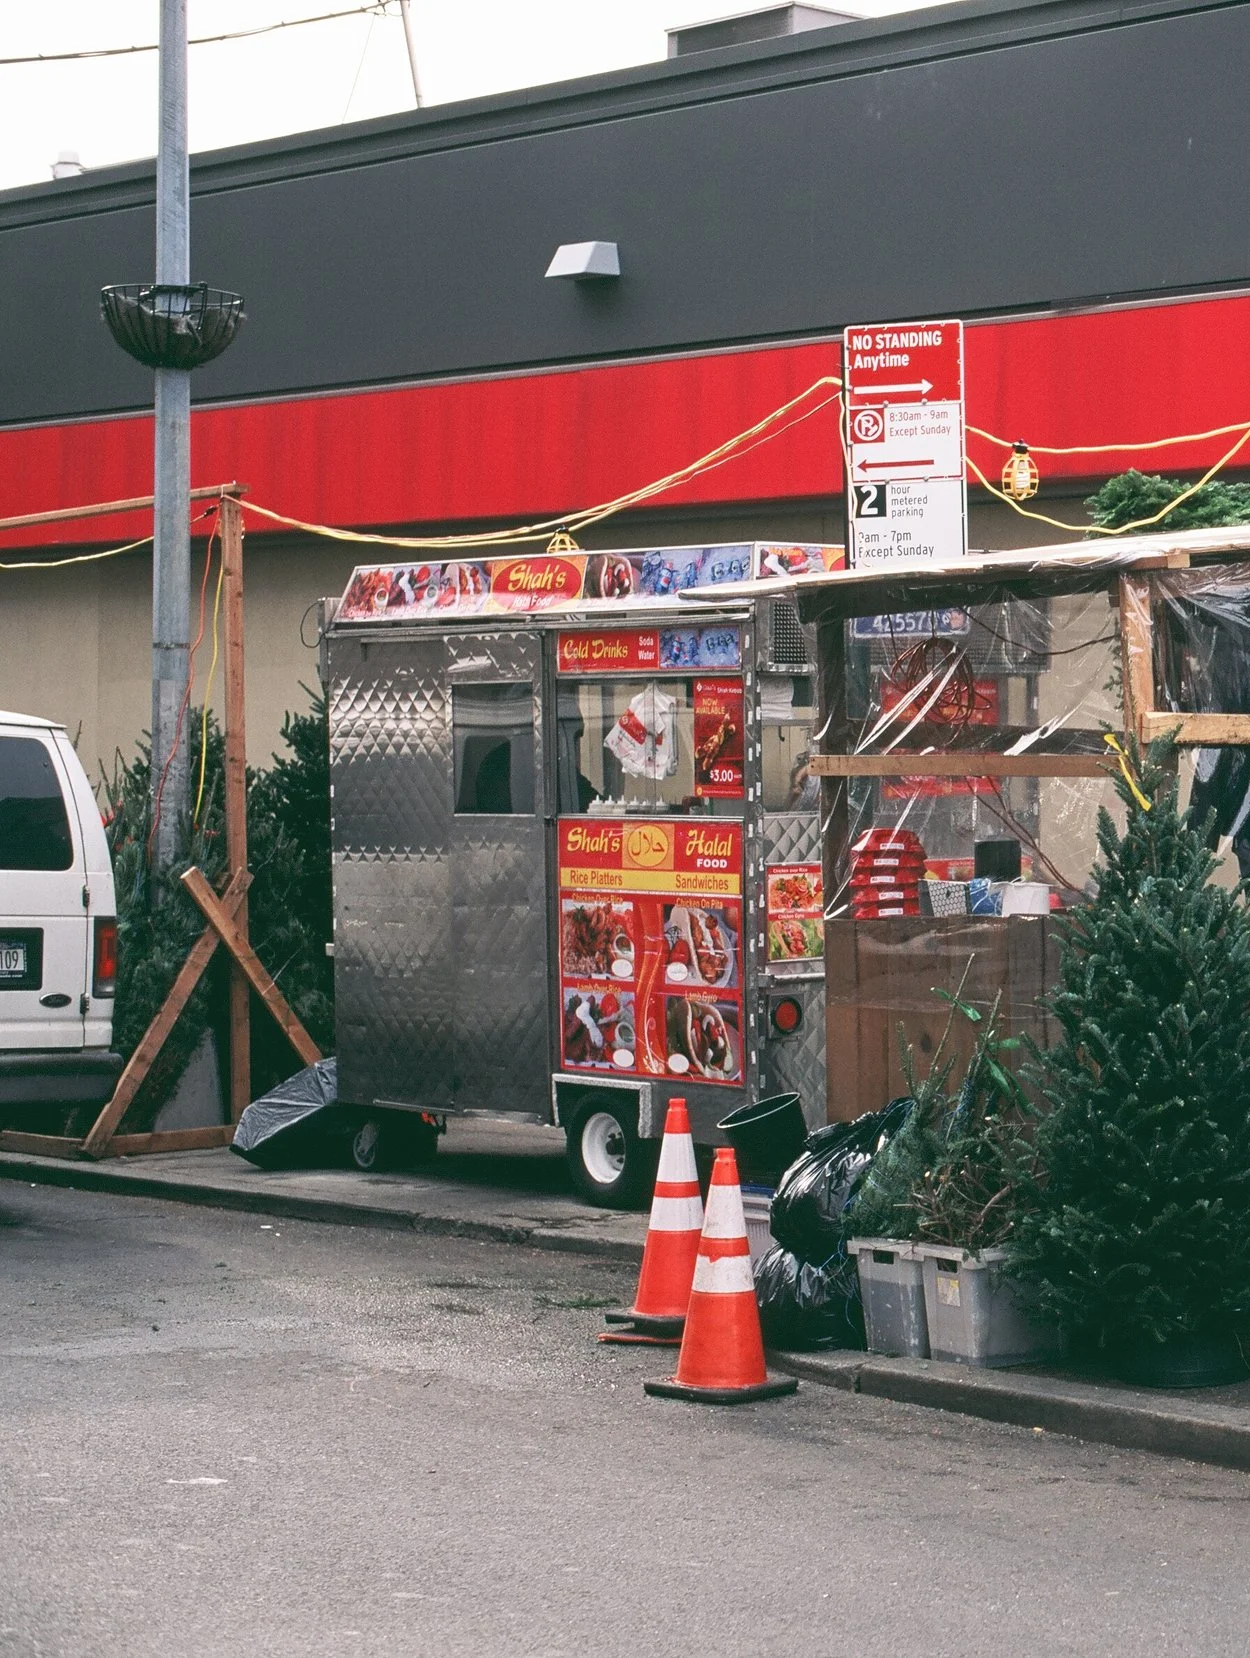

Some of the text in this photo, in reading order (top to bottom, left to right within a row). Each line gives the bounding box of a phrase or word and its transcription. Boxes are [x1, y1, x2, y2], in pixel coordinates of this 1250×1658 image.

[853, 330, 942, 350] NO STANDING
[854, 351, 910, 371] Anytime
[889, 411, 922, 422] 8:30am
[929, 409, 948, 420] 9am
[889, 424, 951, 438] Except Sunday
[891, 485, 910, 494] hour
[860, 485, 878, 515] 2
[891, 494, 928, 506] metered
[891, 506, 924, 519] parking
[891, 530, 912, 544] 7pm
[896, 543, 934, 557] Sunday
[508, 563, 566, 591] Shah's
[638, 636, 654, 647] Soda
[563, 638, 628, 660] Cold Drinks
[638, 650, 655, 661] Water
[702, 698, 718, 706] NOW
[696, 706, 725, 715] AVAILABLE
[710, 769, 733, 782] $3.00
[567, 827, 620, 853] Shah's
[631, 831, 665, 856] حلال
[686, 829, 732, 857] Halal
[697, 858, 727, 868] FOOD
[570, 870, 623, 885] Rice Platters
[675, 875, 729, 890] Sandwiches
[572, 893, 595, 902] Chicken
[676, 897, 723, 909] Chicken On Pita
